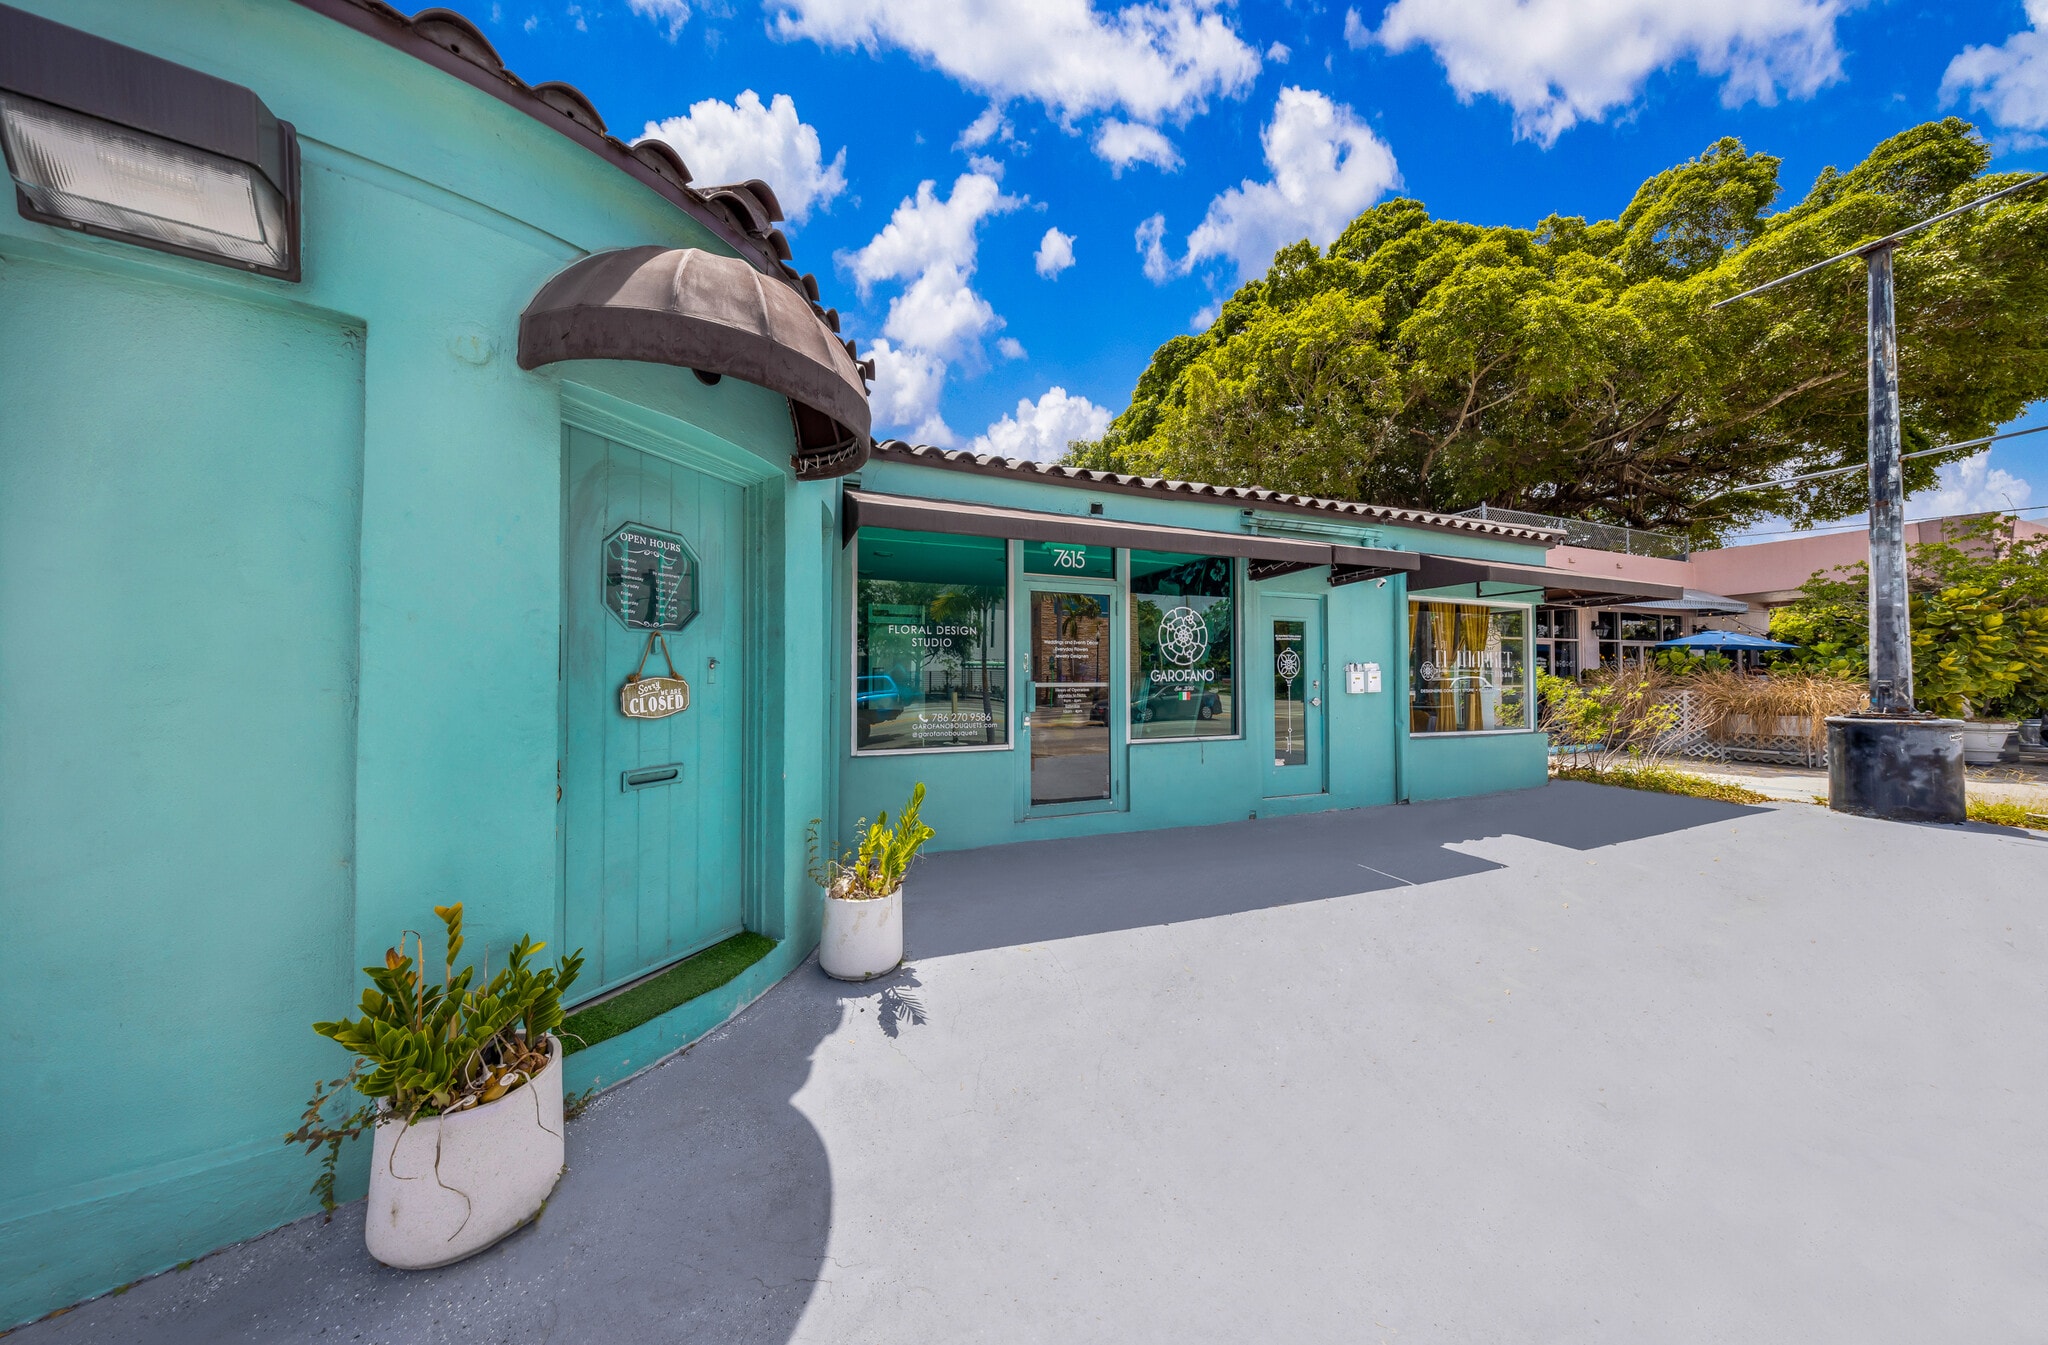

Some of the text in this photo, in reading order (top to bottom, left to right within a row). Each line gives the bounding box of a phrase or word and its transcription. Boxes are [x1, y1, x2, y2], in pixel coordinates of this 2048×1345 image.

[620, 532, 681, 552] OPEN HOURS
[1053, 549, 1085, 568] 7615
[888, 624, 977, 636] FLORAL DESIGN
[911, 637, 952, 648] STUDIO
[1150, 669, 1215, 682] GAROFANO
[637, 681, 661, 695] Sorry
[629, 694, 684, 714] CLOSED
[931, 712, 992, 722] 786 270 9586
[912, 730, 978, 739] @garofanobouquets
